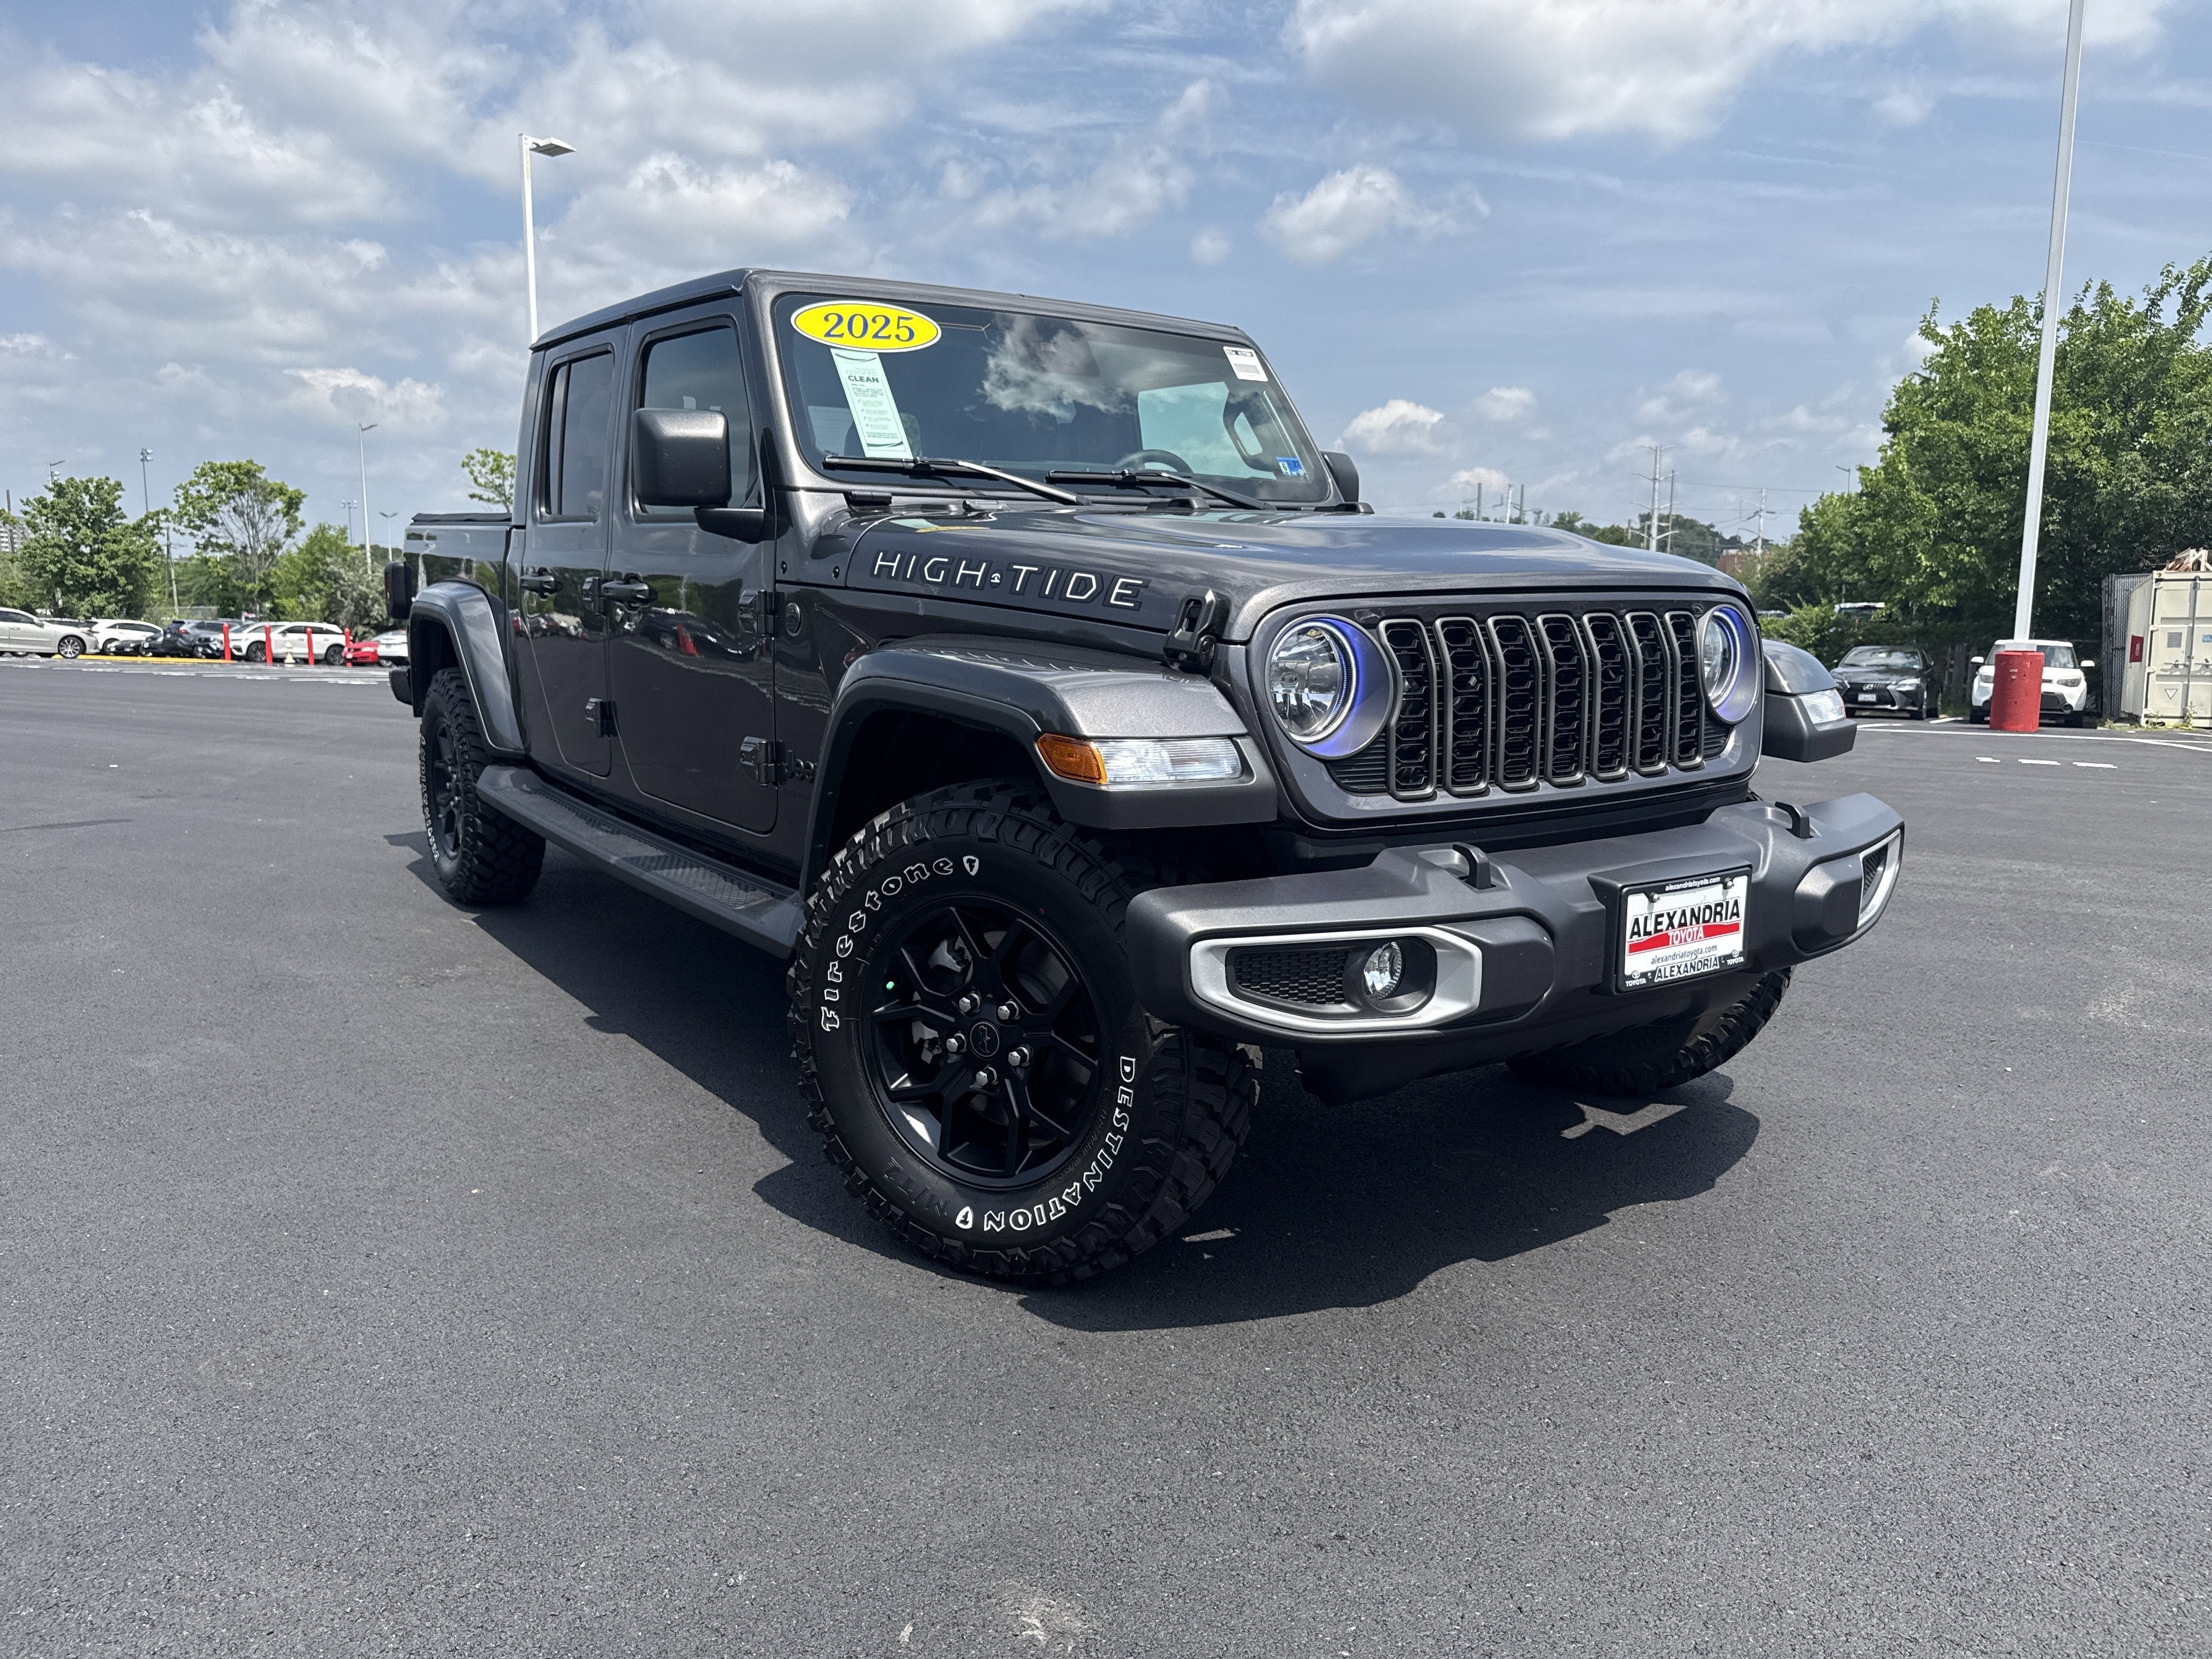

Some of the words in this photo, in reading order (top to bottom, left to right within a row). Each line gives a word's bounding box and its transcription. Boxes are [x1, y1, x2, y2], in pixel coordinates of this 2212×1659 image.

[823, 313, 915, 342] 2025
[1282, 463, 1288, 471] 6
[873, 551, 987, 586] HIGH
[1012, 565, 1143, 606] TIDE
[785, 749, 817, 783] Jee
[1665, 877, 1721, 891] alexandriatoyota.com
[1628, 898, 1741, 940] ALEXANDRIA
[821, 857, 954, 1032] Firestone
[1667, 926, 1705, 946] TOYOTA
[1650, 945, 1718, 965] alexandriatoyota.com
[1625, 977, 1646, 988] TOYOTA
[1655, 956, 1719, 981] ALEXANDRIA
[1726, 956, 1744, 966] TOYOTA
[984, 1056, 1137, 1232] DESTINATION
